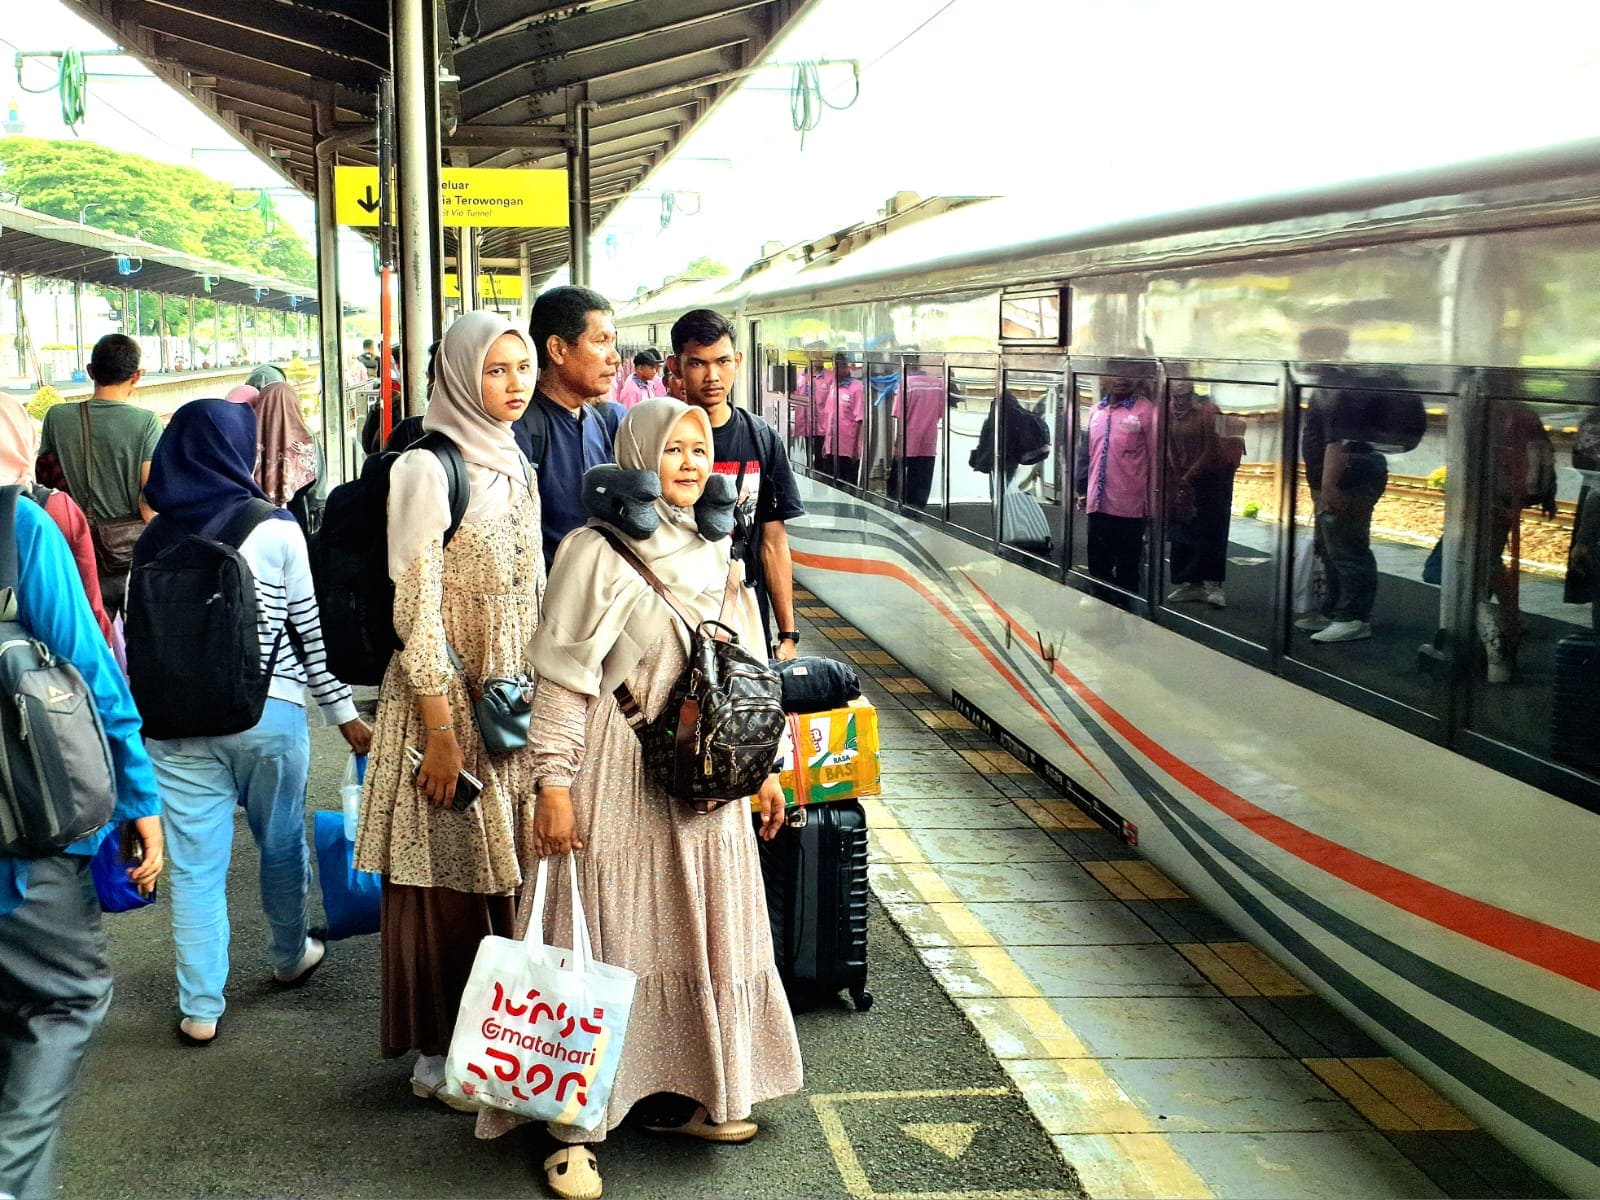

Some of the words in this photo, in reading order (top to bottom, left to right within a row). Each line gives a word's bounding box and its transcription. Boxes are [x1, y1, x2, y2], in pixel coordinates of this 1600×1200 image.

[441, 180, 469, 190] eluar
[442, 195, 451, 205] ia
[454, 195, 523, 208] Terowongan
[466, 209, 493, 217] Tunnel
[833, 754, 850, 764] RASA
